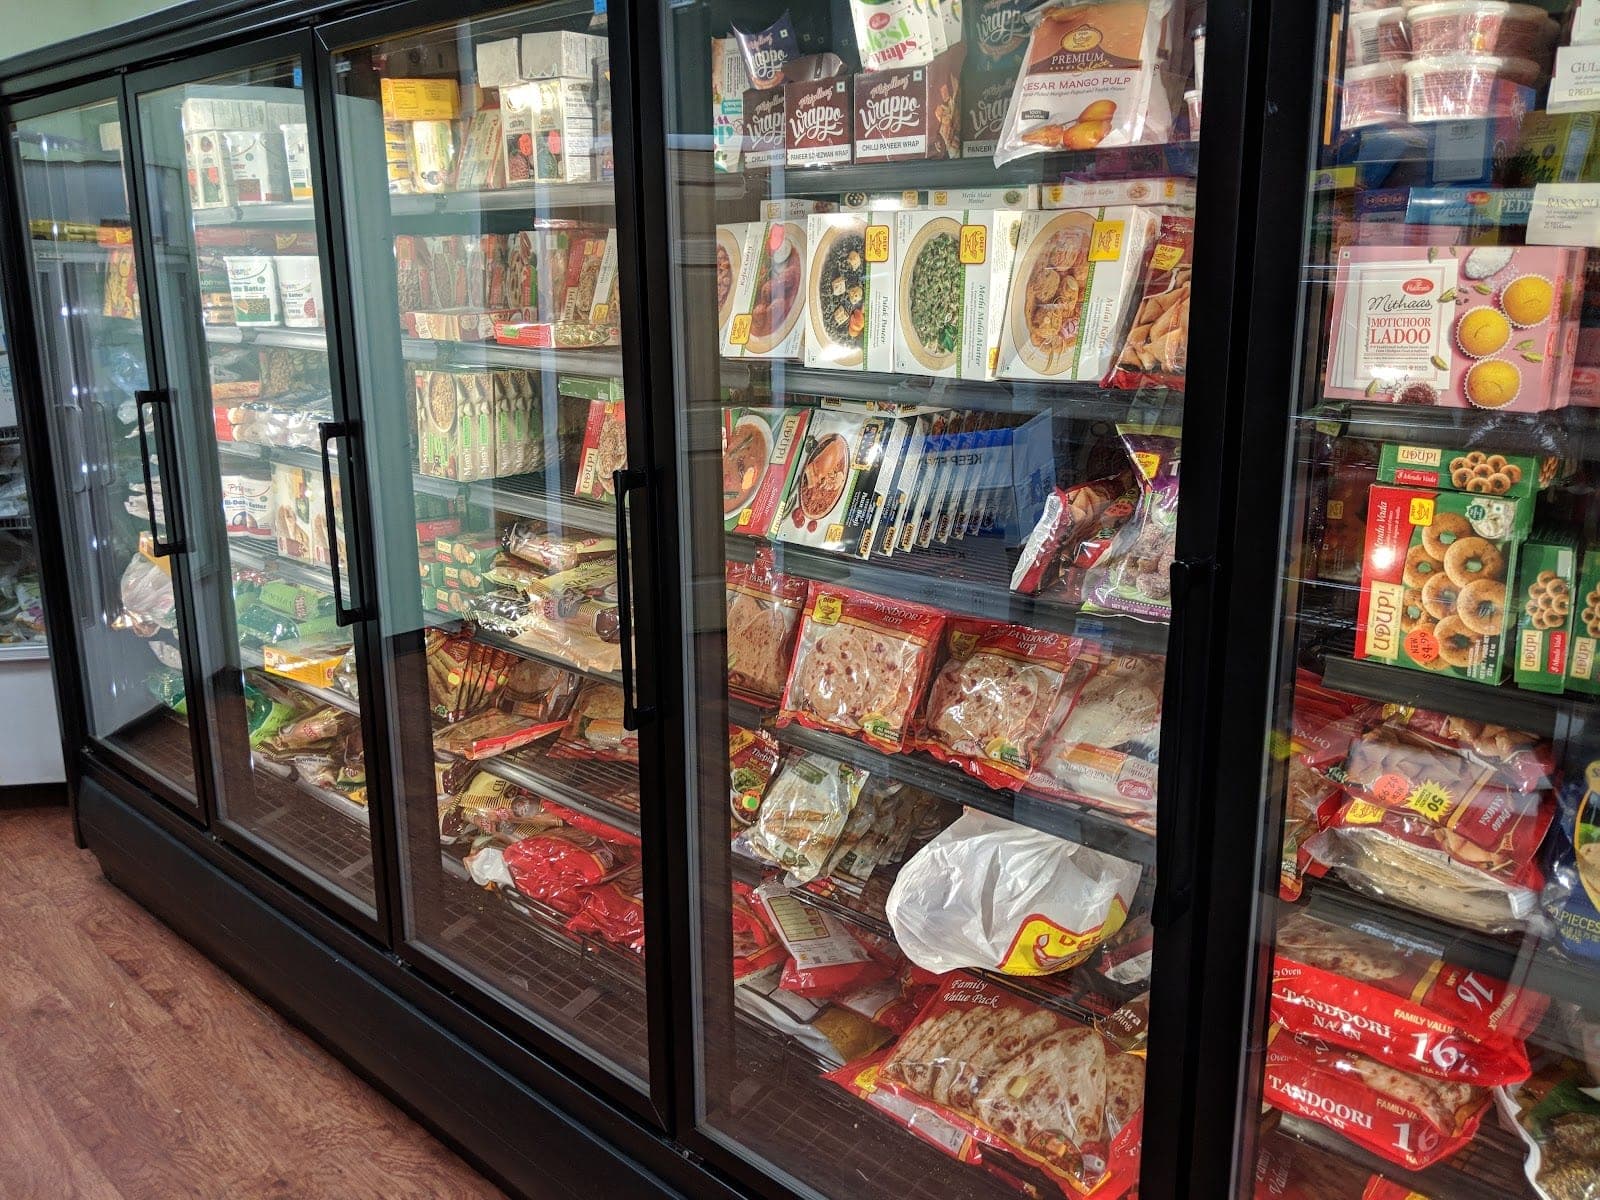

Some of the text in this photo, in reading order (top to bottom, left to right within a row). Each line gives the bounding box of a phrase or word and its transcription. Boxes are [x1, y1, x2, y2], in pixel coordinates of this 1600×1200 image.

[1052, 52, 1104, 65] PREMIUM
[1060, 78, 1099, 89] MANGO
[1102, 77, 1132, 85] PULP
[862, 140, 920, 152] CHILLI PANEER WRAP
[1103, 297, 1114, 323] Malai
[1368, 295, 1433, 312] Mithaas
[880, 296, 889, 345] Palak Paneer
[975, 285, 986, 367] Methi Malai Mutter
[1371, 317, 1431, 328] MOTICHOOR
[1370, 328, 1431, 345] LADOO
[1400, 447, 1437, 464] UDUPI
[1376, 499, 1388, 522] Vada
[875, 603, 920, 621] TANDOORI
[1372, 590, 1395, 650] UDUPI
[1409, 638, 1420, 654] NEW
[1524, 634, 1537, 668] UDUPI
[1575, 639, 1590, 675] UDUPI
[1427, 794, 1444, 812] 50
[1281, 968, 1301, 976] Oven
[951, 979, 988, 993] Family
[1456, 972, 1494, 1012] 16
[944, 992, 1001, 1009] Value Pack
[1283, 987, 1391, 1038] TANDOORI
[1394, 1008, 1426, 1026] FAMILY
[1270, 1053, 1289, 1062] Oven
[1408, 1033, 1459, 1069] 16
[1269, 1074, 1374, 1129] TANDOORI
[1376, 1097, 1406, 1116] FAMILY
[1393, 1122, 1440, 1154] 16
